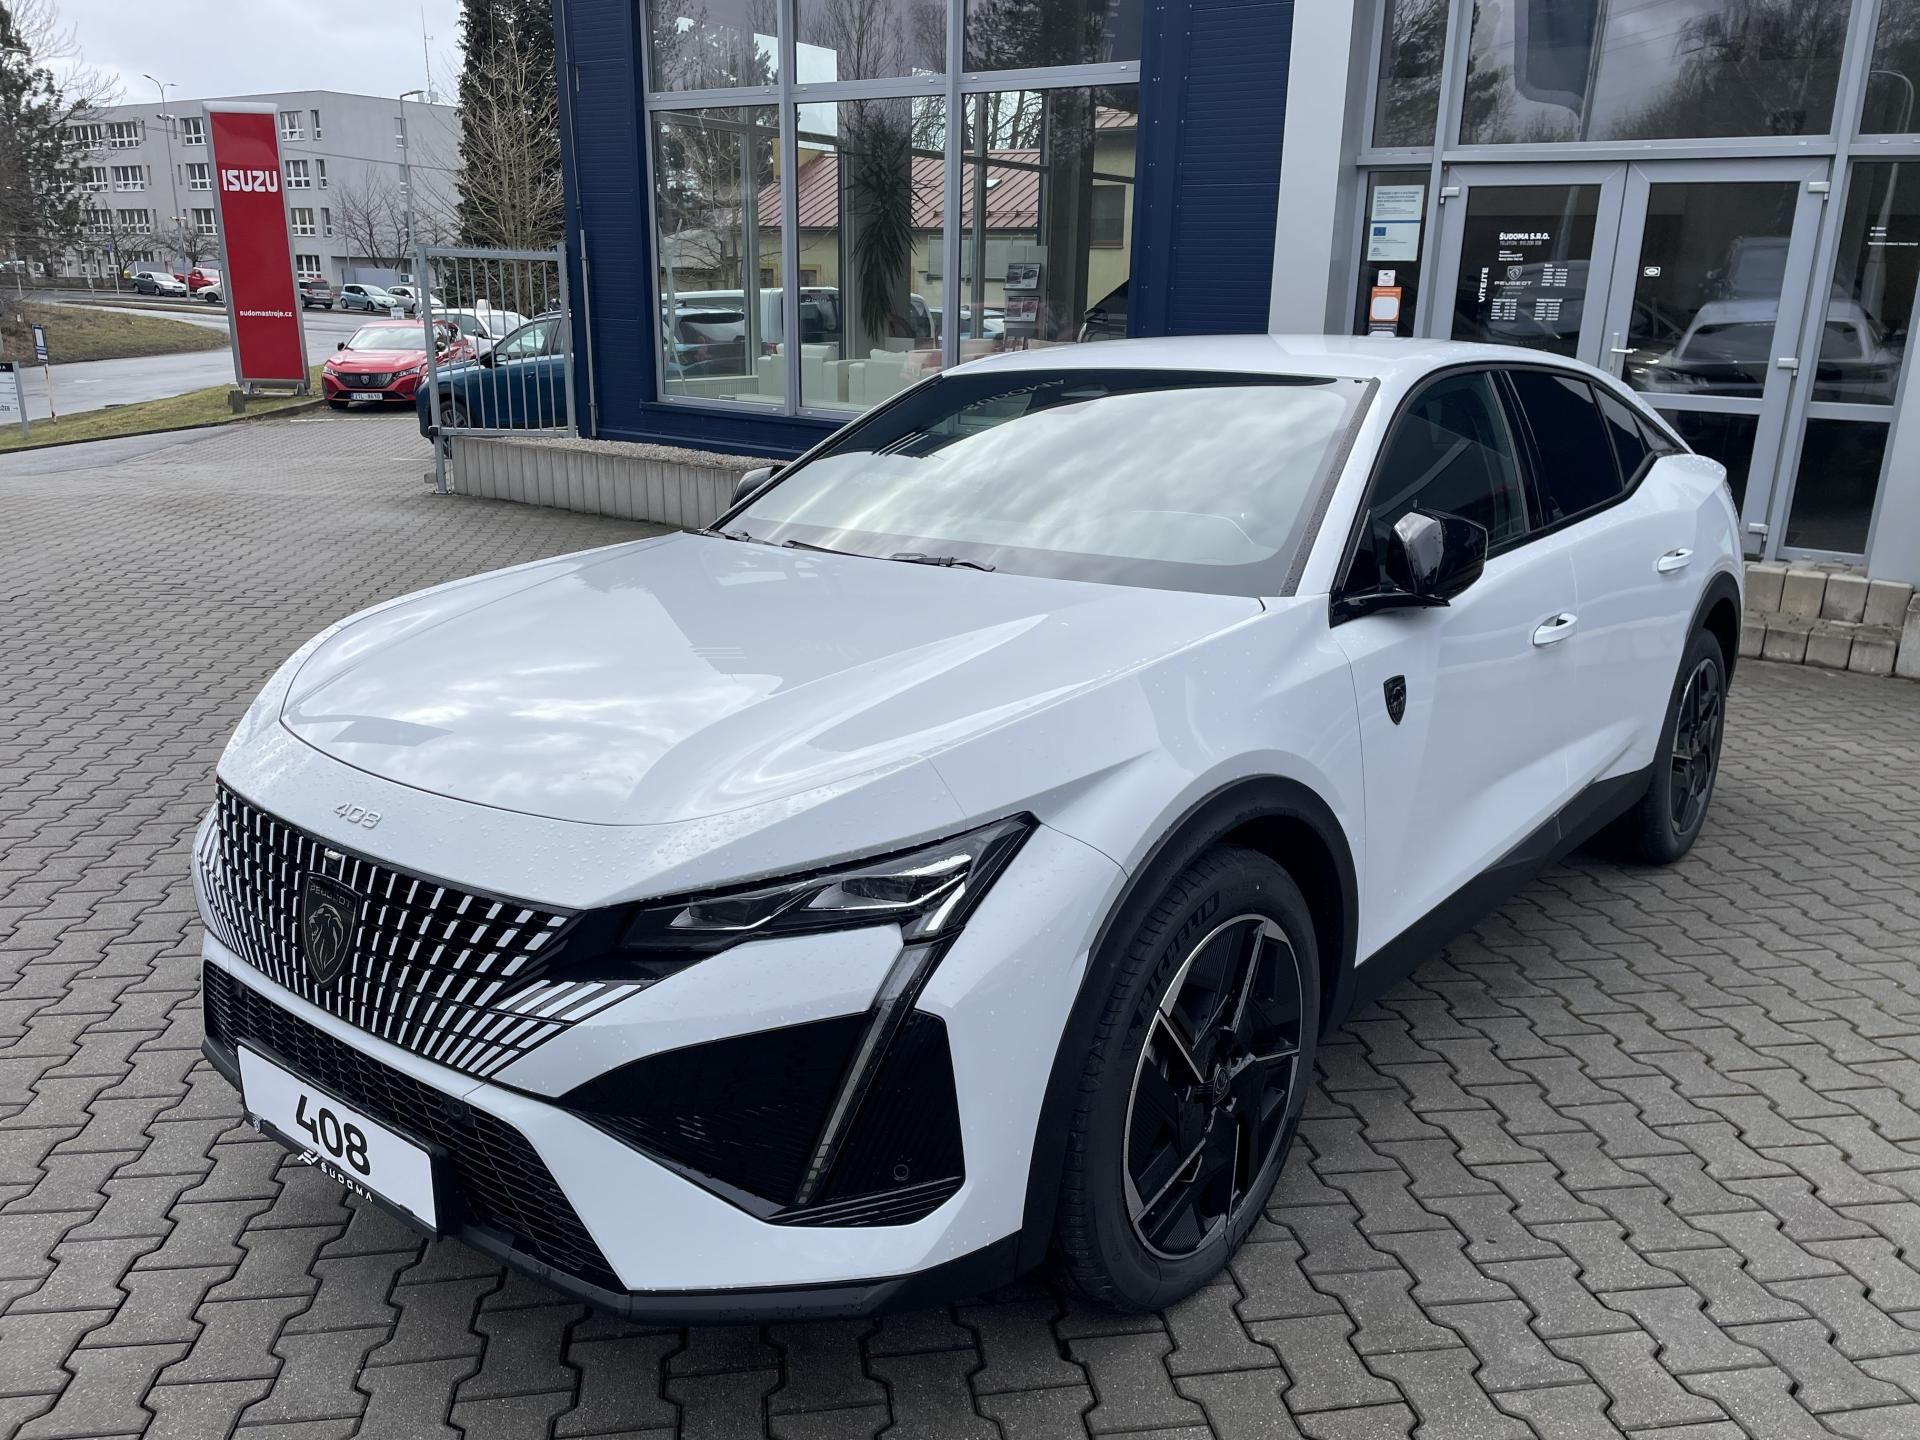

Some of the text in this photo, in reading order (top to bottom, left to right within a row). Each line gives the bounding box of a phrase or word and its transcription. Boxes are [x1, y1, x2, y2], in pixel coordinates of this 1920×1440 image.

[221, 169, 279, 193] ISUZU
[239, 309, 293, 319] sudomastroje.cz
[333, 802, 383, 830] 408
[295, 1093, 371, 1176] 408
